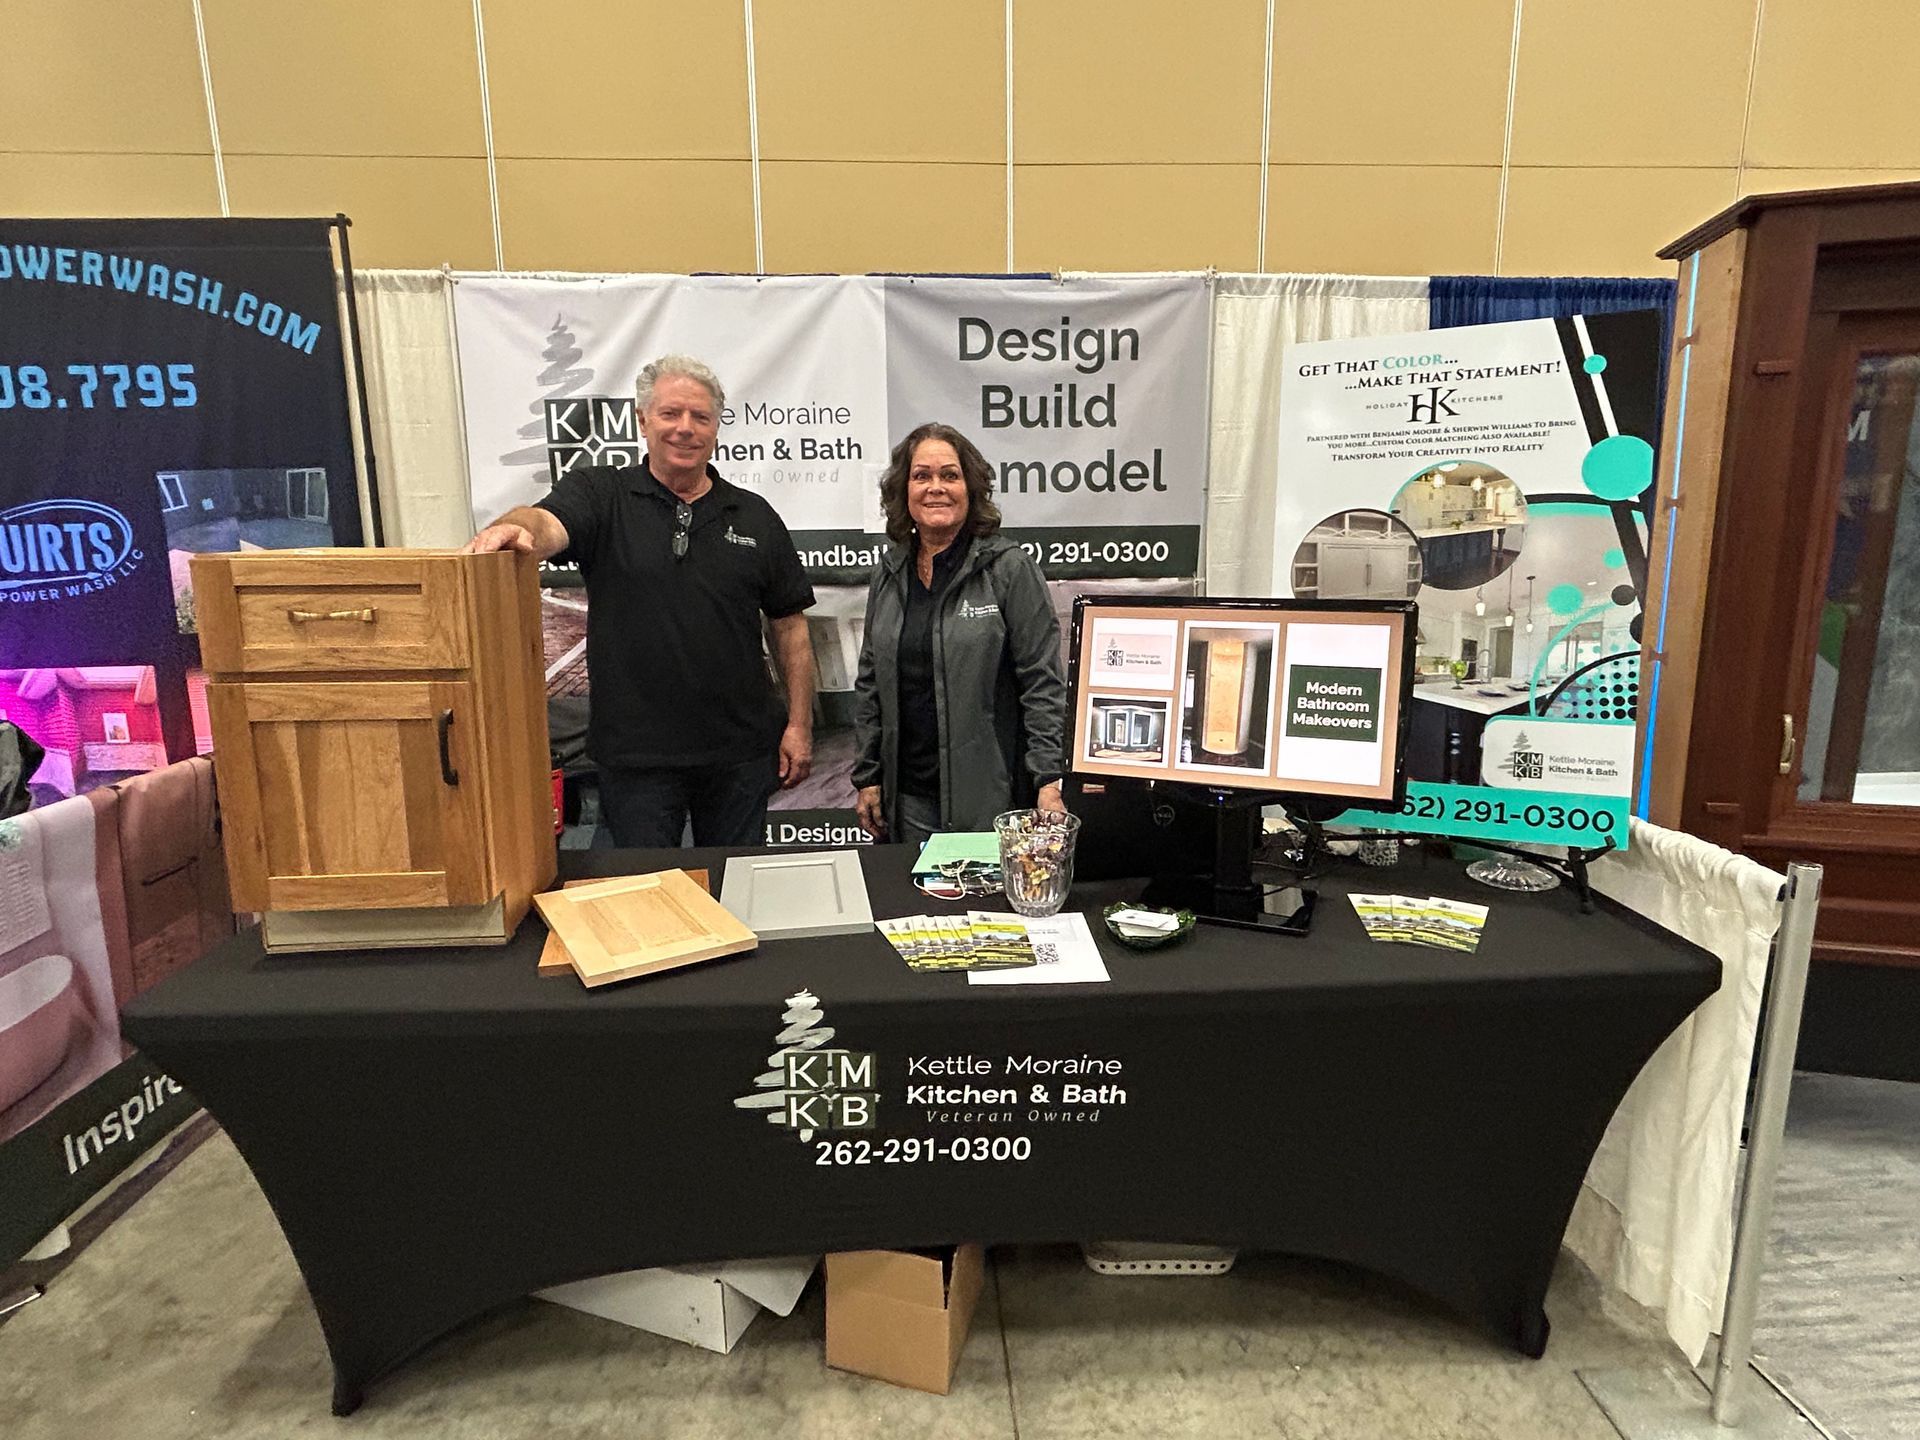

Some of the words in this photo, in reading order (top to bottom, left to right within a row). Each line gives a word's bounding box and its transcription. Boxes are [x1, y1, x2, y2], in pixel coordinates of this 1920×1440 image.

[958, 316, 1139, 374] Design
[1299, 364, 1330, 377] GET
[1335, 360, 1379, 374] THAT
[1383, 354, 1458, 369] COLOR...
[1345, 375, 1403, 390] ...MAKE
[1407, 371, 1451, 384] THAT
[1456, 361, 1561, 381] STATEMENT!
[745, 401, 850, 425] Moraine
[981, 383, 1117, 429] Build
[1366, 402, 1409, 410] HOLIDAY
[1451, 395, 1503, 404] KITCHENS
[1307, 434, 1349, 442] PARTNERED
[1373, 430, 1411, 438] BENJAMIN
[1412, 428, 1441, 436] MOORE
[1452, 425, 1489, 433] SHERWIN
[1435, 435, 1479, 443] MATCHING
[1503, 430, 1551, 439] AVAILABLE!
[773, 438, 793, 460] &
[801, 437, 862, 460] Bath
[1332, 453, 1386, 461] TRANSFORM
[1388, 450, 1414, 458] YOUR
[1416, 447, 1471, 457] CREATIVITY
[1474, 446, 1499, 454] INTO
[1502, 443, 1544, 452] REALITY
[773, 467, 840, 484] Owned
[796, 544, 888, 567] andbat
[1049, 541, 1169, 564] 291-0300
[65, 573, 117, 597] WASH
[119, 549, 144, 577] LLC
[1306, 682, 1363, 696] Modern
[1297, 697, 1369, 713] Bathroom
[1293, 712, 1373, 729] Makeovers
[1549, 765, 1584, 774] Kitchen
[1586, 767, 1594, 775] &
[1596, 768, 1618, 776] Bath
[1385, 795, 1445, 820] 62)
[1454, 799, 1615, 833] 291-0300
[780, 822, 874, 845] Designs
[908, 1055, 993, 1076] Kettle
[1005, 1054, 1123, 1076] Moraine
[907, 1084, 1018, 1105] Kitchen
[1030, 1085, 1050, 1104] &
[1063, 1084, 1127, 1105] Bath
[926, 1110, 1013, 1124] Veteran
[1028, 1109, 1101, 1122] Owned
[815, 1137, 1032, 1166] 262-291-0300
